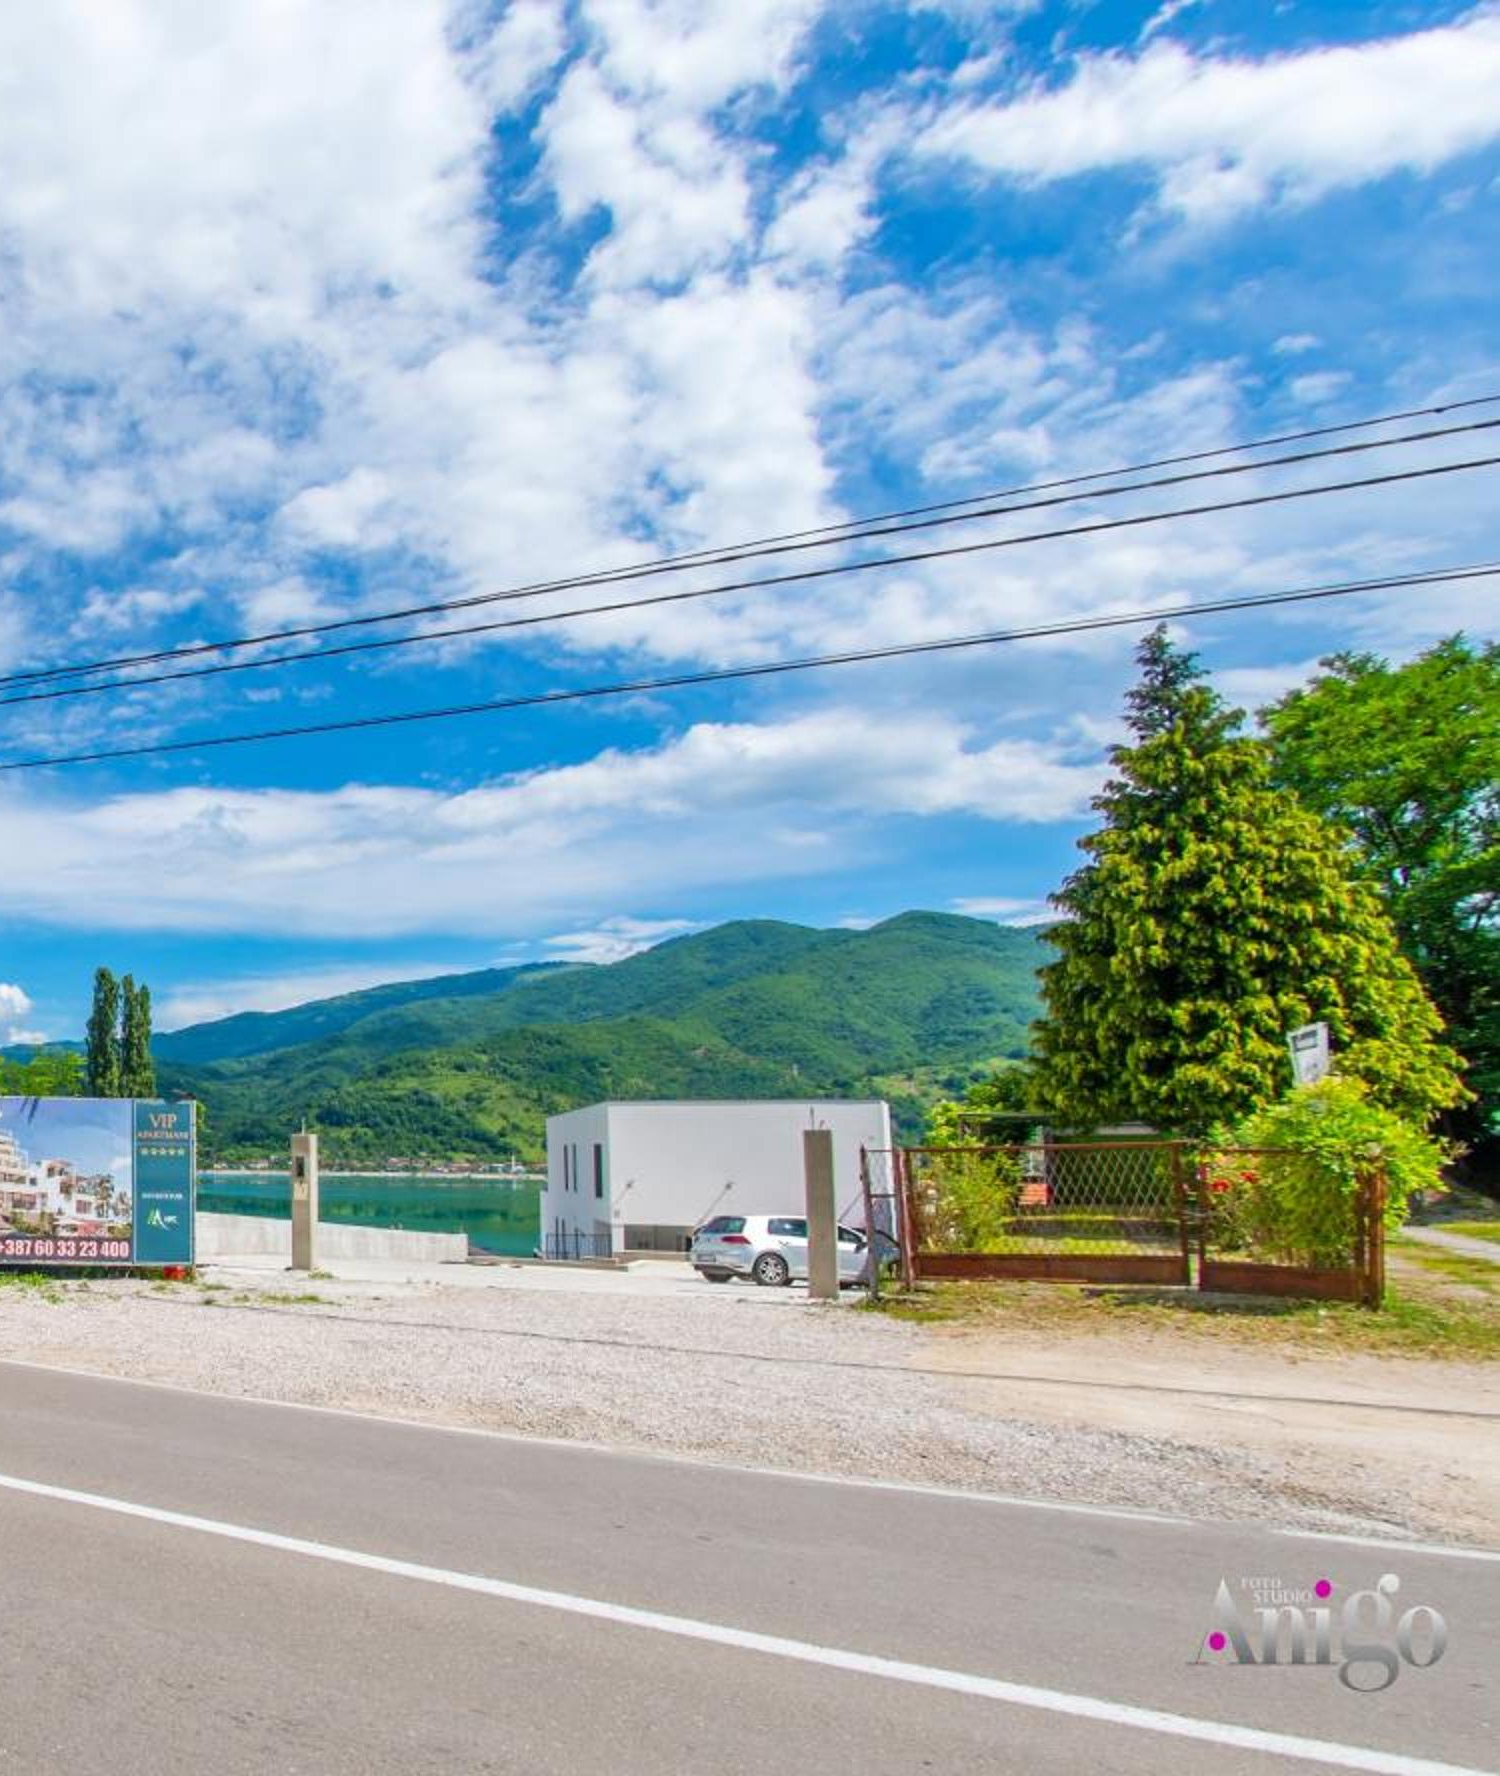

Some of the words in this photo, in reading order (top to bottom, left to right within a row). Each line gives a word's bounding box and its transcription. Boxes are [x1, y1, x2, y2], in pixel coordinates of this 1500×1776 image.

[149, 1112, 177, 1128] VIP
[34, 1240, 54, 1257] 60
[57, 1241, 76, 1257] 33
[79, 1241, 98, 1257] 23
[101, 1241, 130, 1258] 400
